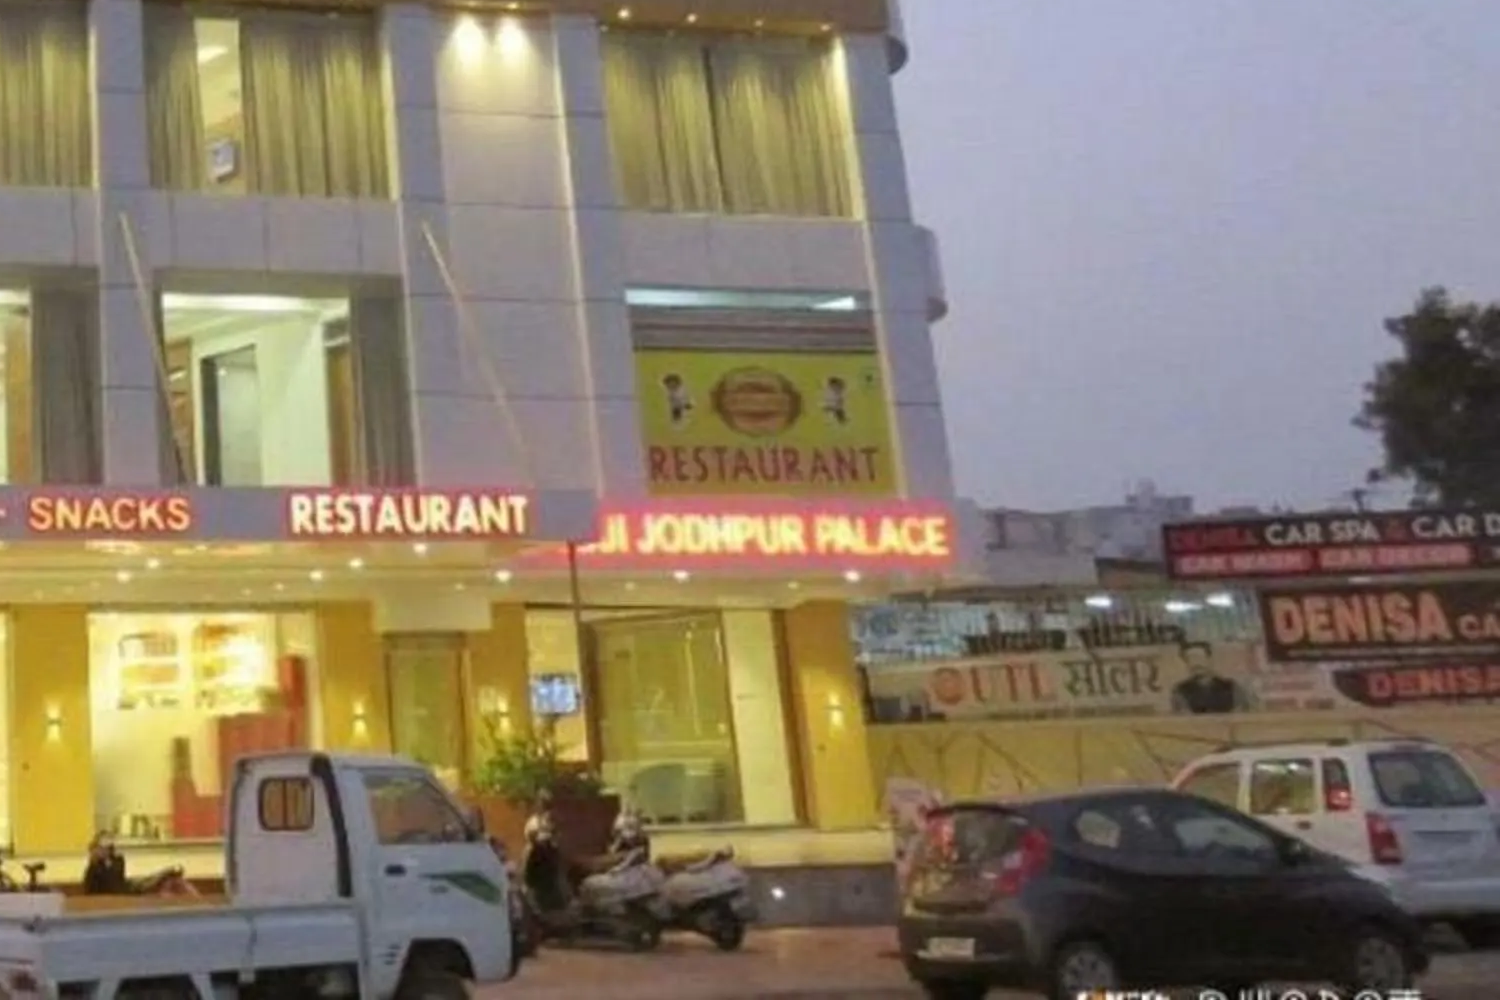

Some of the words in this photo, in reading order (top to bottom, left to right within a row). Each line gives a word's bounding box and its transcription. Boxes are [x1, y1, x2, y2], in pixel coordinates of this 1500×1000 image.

[650, 446, 879, 483] RESTAURANT
[29, 497, 191, 531] SNACKS
[290, 495, 529, 534] RESTAURANT
[1264, 520, 1325, 545] CAR
[1329, 518, 1381, 542] SPA
[1411, 511, 1477, 538] CAR
[577, 512, 630, 553] JI
[637, 511, 809, 555] JODHPUR
[816, 514, 949, 556] PALACE
[1269, 590, 1454, 646] DENISA
